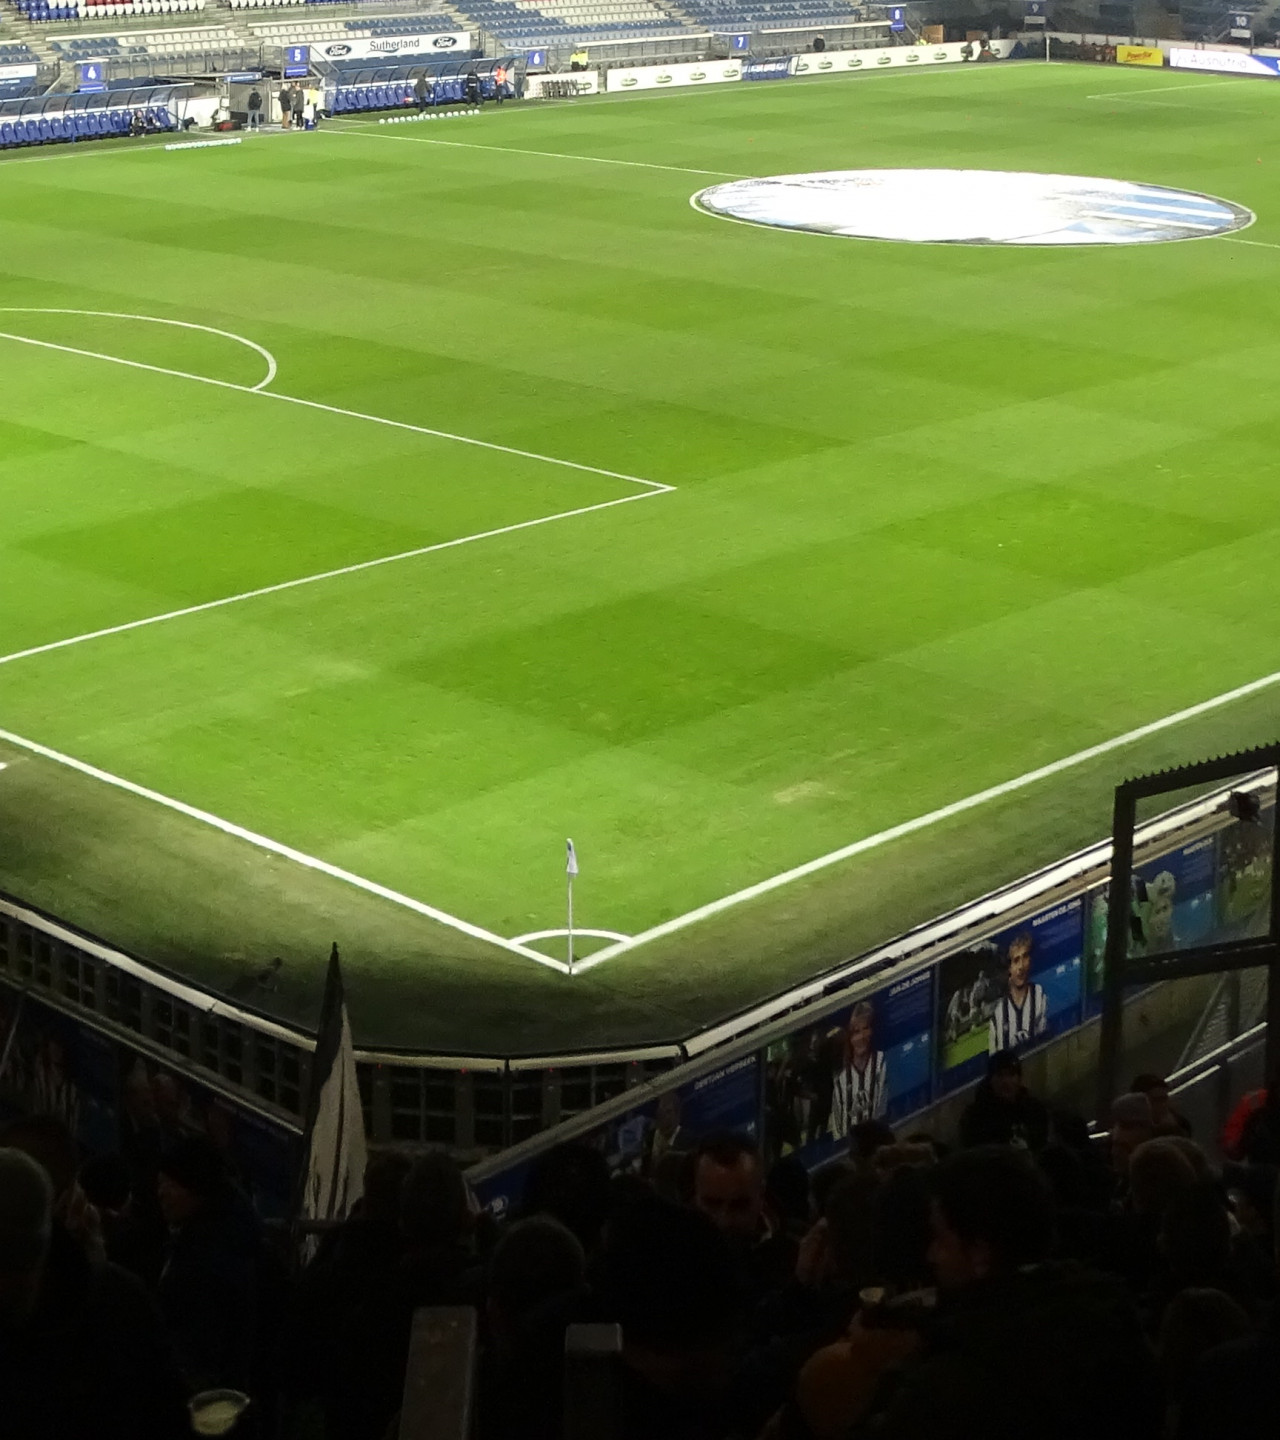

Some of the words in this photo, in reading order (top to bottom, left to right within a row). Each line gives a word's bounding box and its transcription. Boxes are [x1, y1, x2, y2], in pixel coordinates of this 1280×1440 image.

[894, 8, 900, 19] 8
[1235, 16, 1247, 27] 10
[370, 38, 420, 51] Sutherland
[436, 38, 454, 48] Ford
[737, 37, 744, 48] 7
[293, 49, 301, 61] 5
[329, 46, 348, 56] Ford
[532, 52, 540, 64] 6
[86, 65, 96, 79] 4
